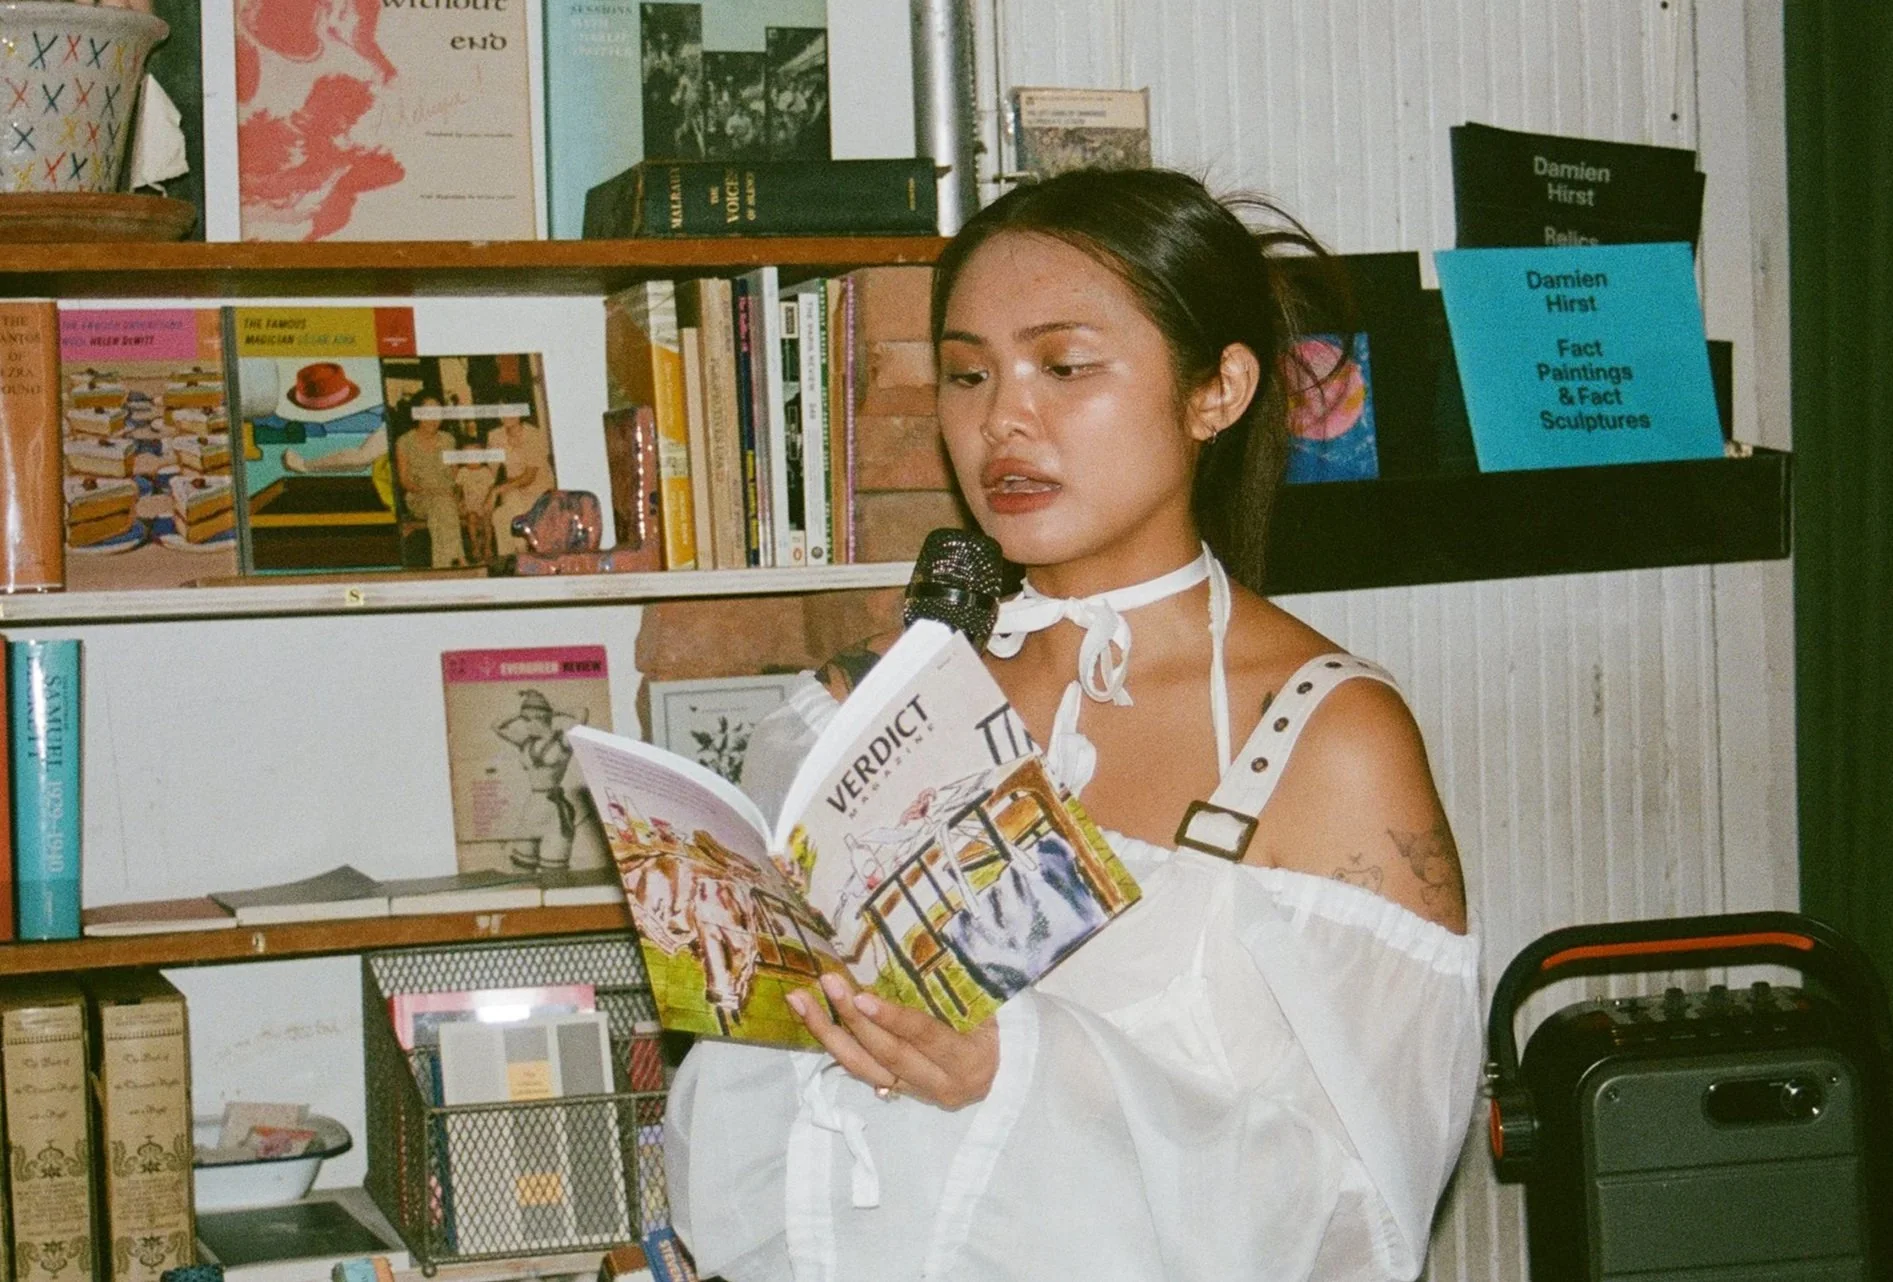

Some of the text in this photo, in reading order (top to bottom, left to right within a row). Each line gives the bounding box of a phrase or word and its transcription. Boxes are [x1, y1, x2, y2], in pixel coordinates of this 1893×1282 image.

[450, 32, 508, 50] end
[1533, 155, 1611, 183] Damien
[669, 166, 682, 229] MALRAUX
[1547, 183, 1595, 207] Hirst
[1526, 269, 1609, 290] Damien
[1546, 294, 1597, 313] Hirst
[0, 331, 41, 345] ANTOS
[1556, 338, 1604, 358] Fact
[1536, 361, 1633, 385] Paintings
[1, 384, 41, 396] OUND
[1558, 385, 1624, 406] & Fact
[1540, 410, 1651, 433] Sculptures
[350, 589, 361, 602] S
[562, 660, 601, 673] REVIEW
[44, 674, 62, 772] SAMUEL
[826, 694, 928, 814] VERDICT
[850, 723, 936, 819] MAGAZINE
